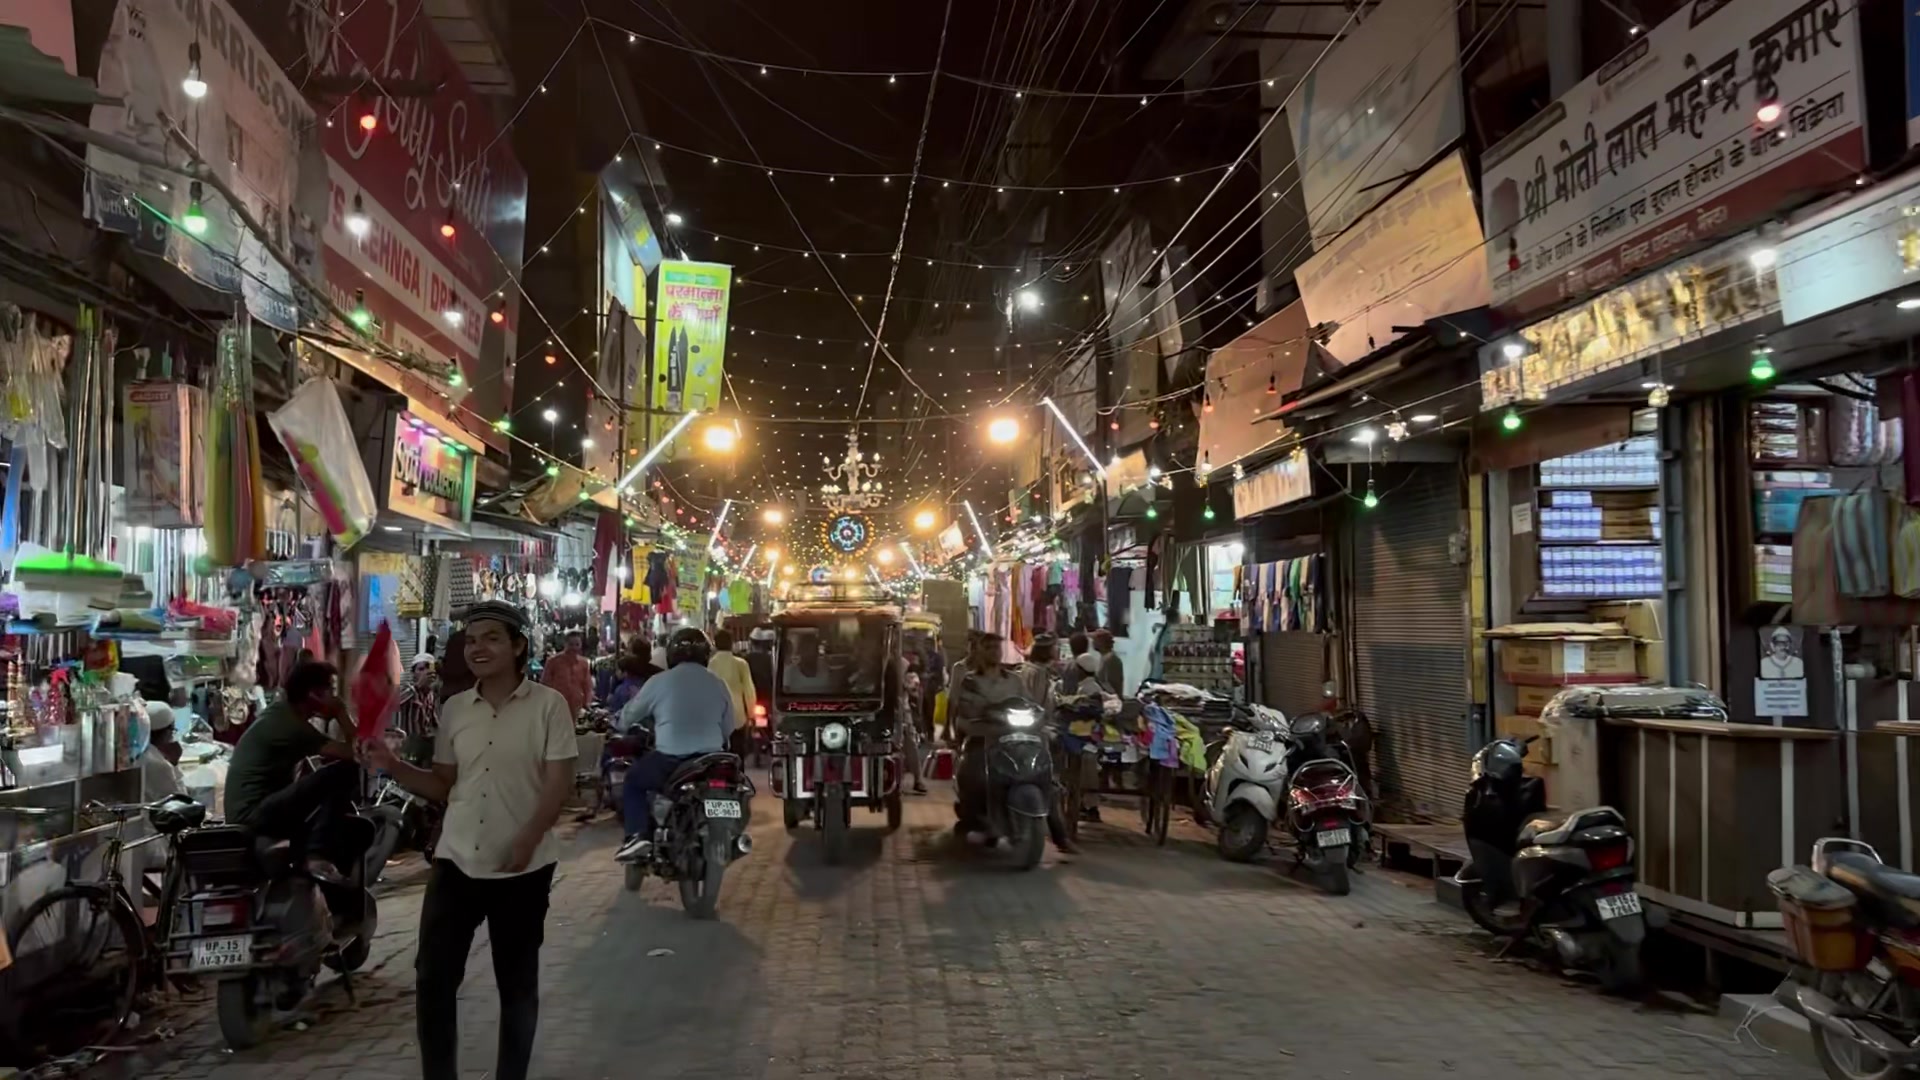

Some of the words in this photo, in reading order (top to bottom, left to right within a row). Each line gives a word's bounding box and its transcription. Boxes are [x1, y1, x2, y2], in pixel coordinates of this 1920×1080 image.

[175, 0, 314, 140] ARRISON
[1524, 153, 1550, 223] श्री
[1553, 122, 1598, 203] मोती
[1605, 101, 1658, 176] लाल
[1665, 53, 1740, 140] महेन्द्र
[1749, 0, 1842, 101] कुमार
[1729, 138, 1746, 168] के
[205, 940, 239, 952] UP-15
